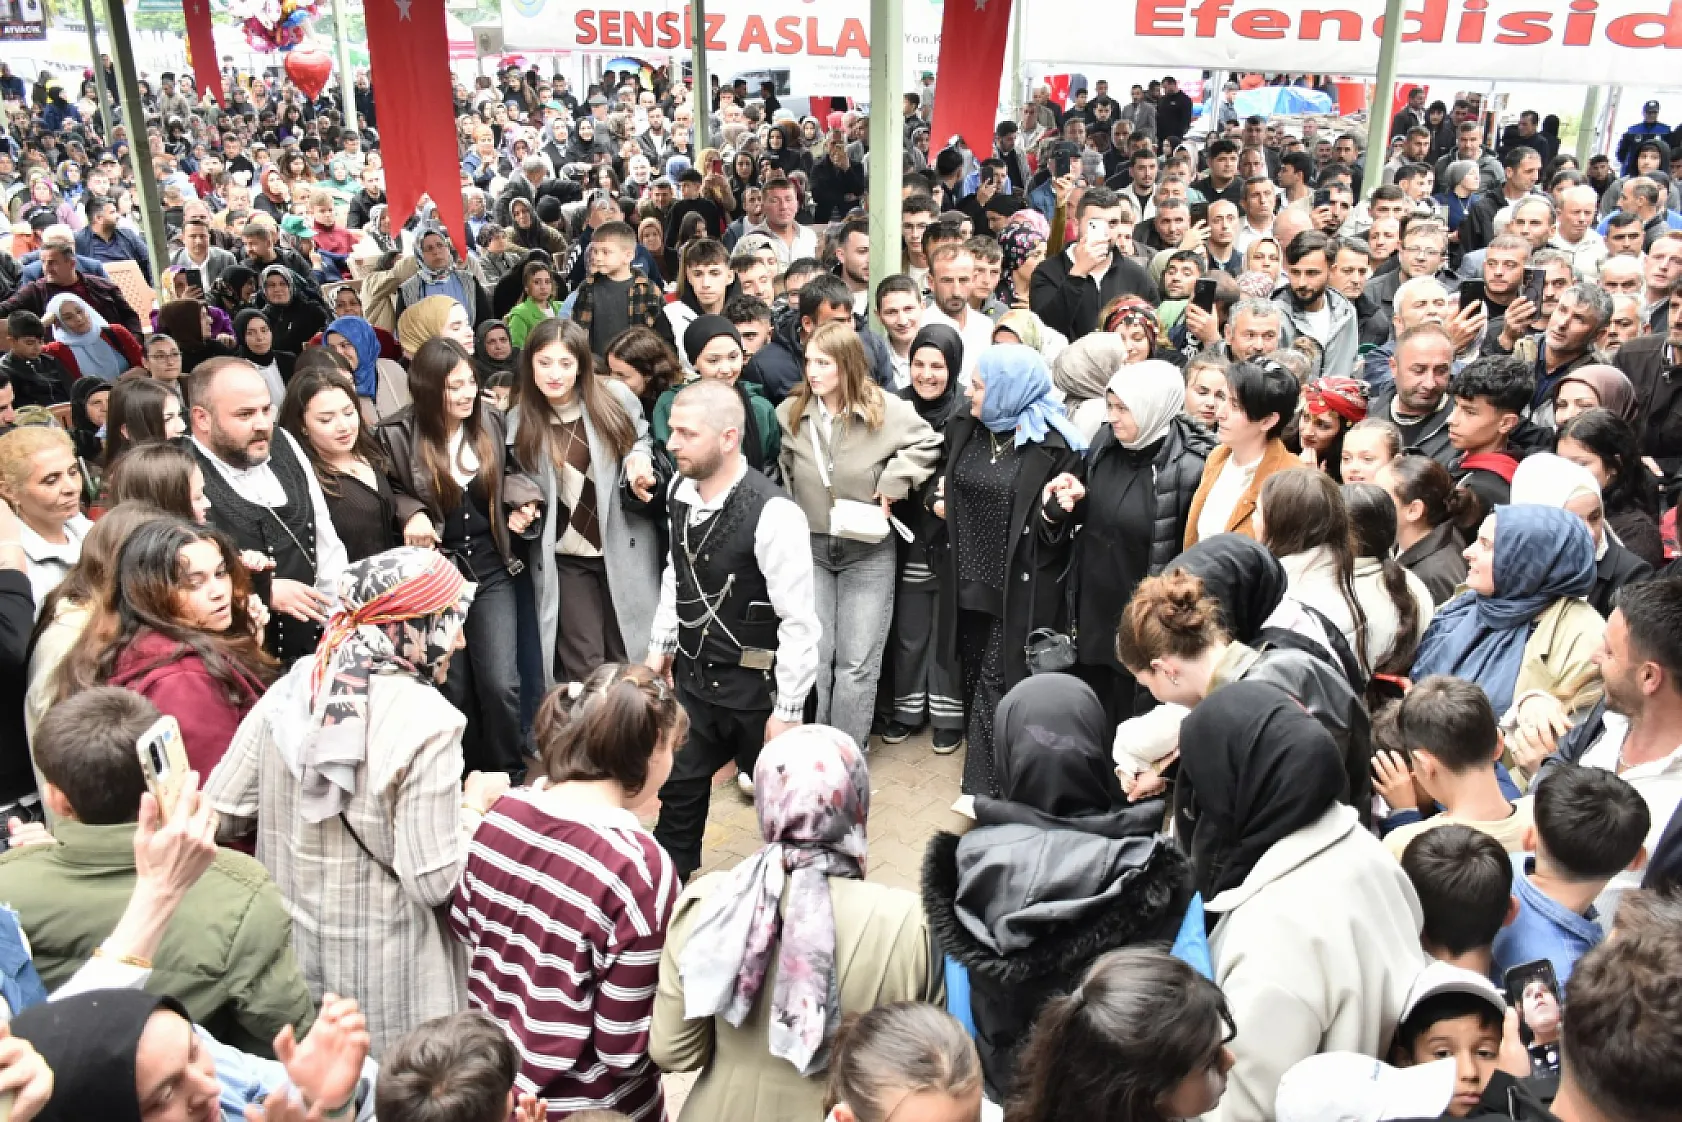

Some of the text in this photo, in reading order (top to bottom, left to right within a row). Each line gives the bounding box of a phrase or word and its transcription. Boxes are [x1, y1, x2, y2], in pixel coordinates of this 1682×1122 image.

[575, 5, 872, 59] SENSİZ ASLA
[1134, 0, 1682, 49] Efendisid
